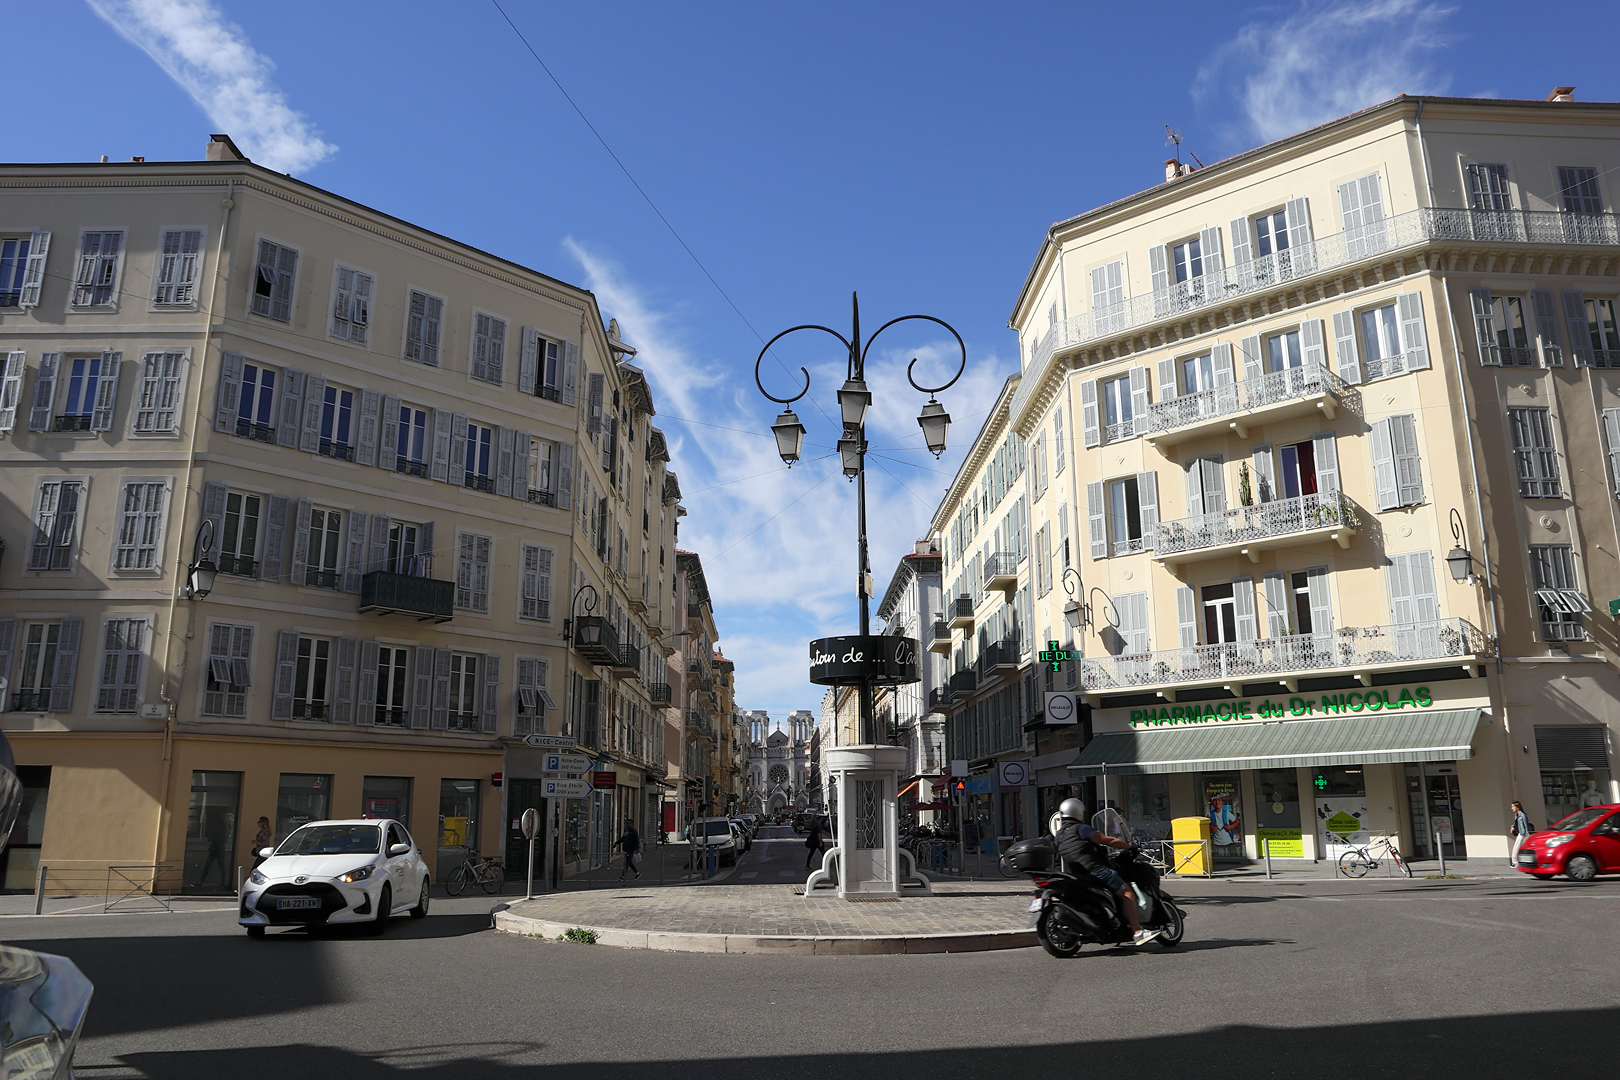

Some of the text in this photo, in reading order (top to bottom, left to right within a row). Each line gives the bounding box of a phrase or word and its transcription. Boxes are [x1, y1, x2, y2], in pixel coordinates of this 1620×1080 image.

[842, 647, 864, 664] de
[1130, 687, 1432, 726] PHARMACIE du Dr NICOLAS
